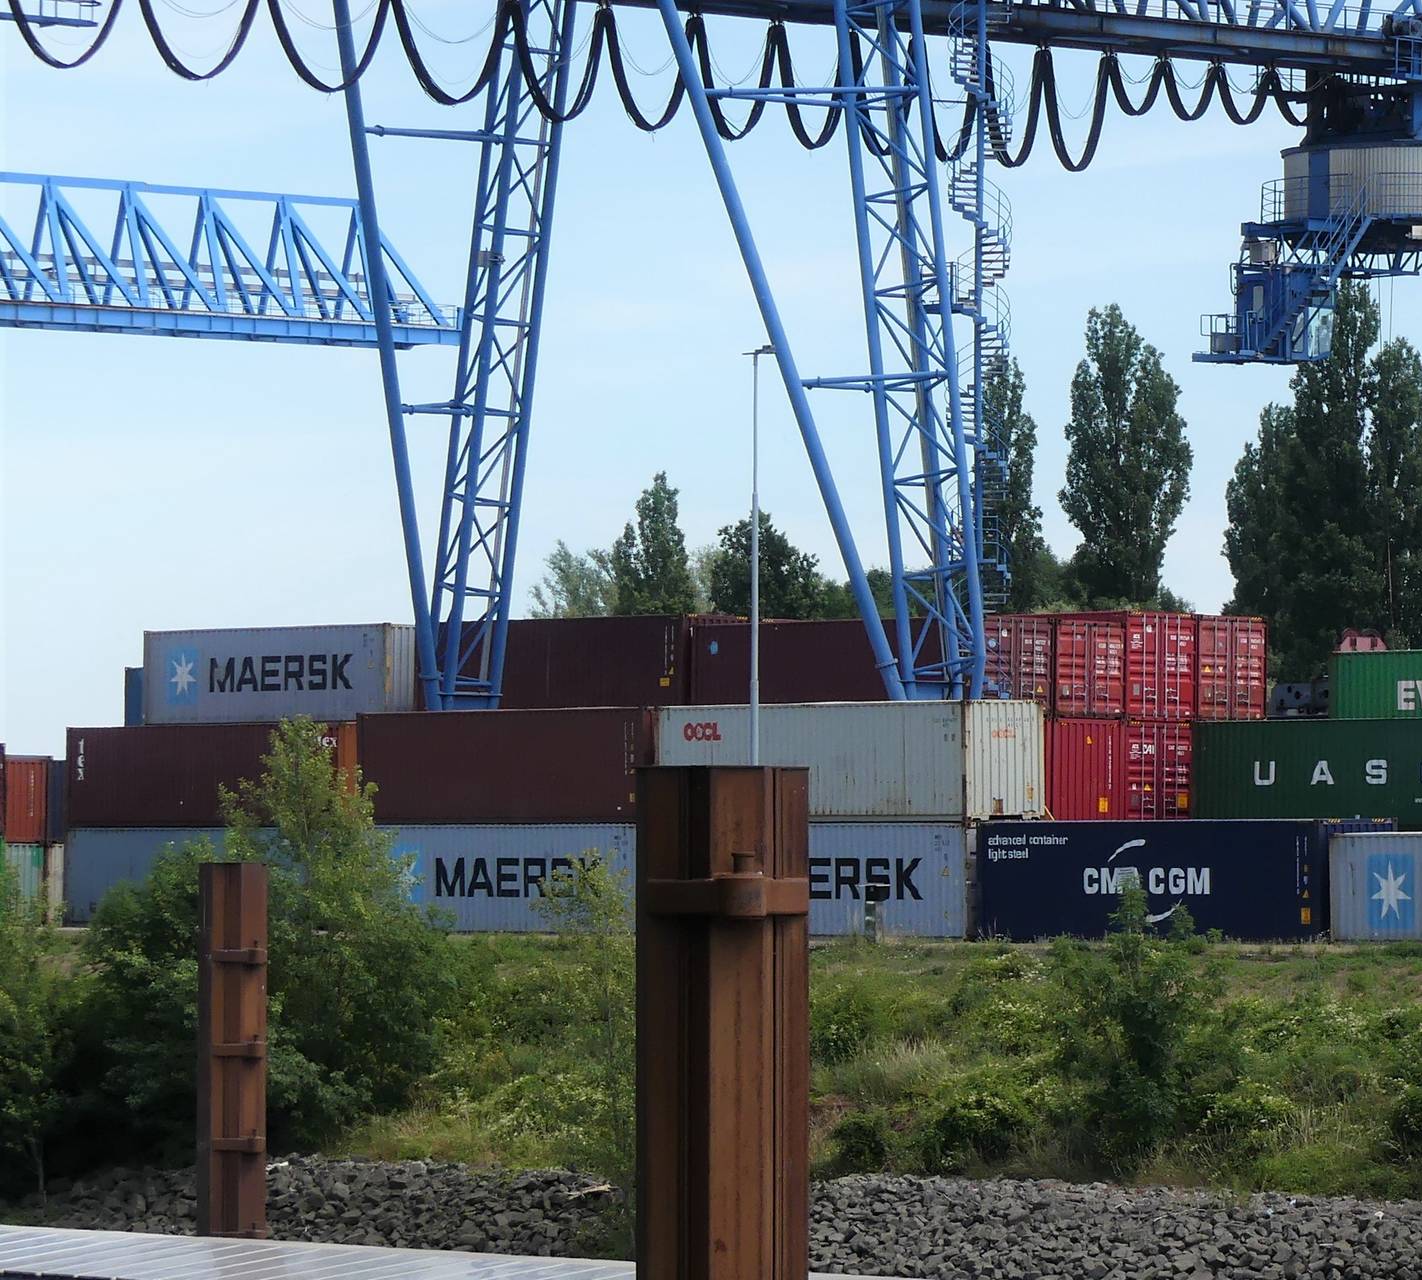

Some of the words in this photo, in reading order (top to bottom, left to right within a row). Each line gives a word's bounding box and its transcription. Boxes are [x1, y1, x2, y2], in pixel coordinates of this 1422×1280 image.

[209, 653, 354, 693] MAERSK
[683, 722, 722, 742] OOCL
[988, 833, 1027, 846] advanced
[1029, 834, 1068, 846] container
[988, 848, 1007, 862] light
[1008, 848, 1029, 860] steel
[1148, 867, 1211, 895] CGM
